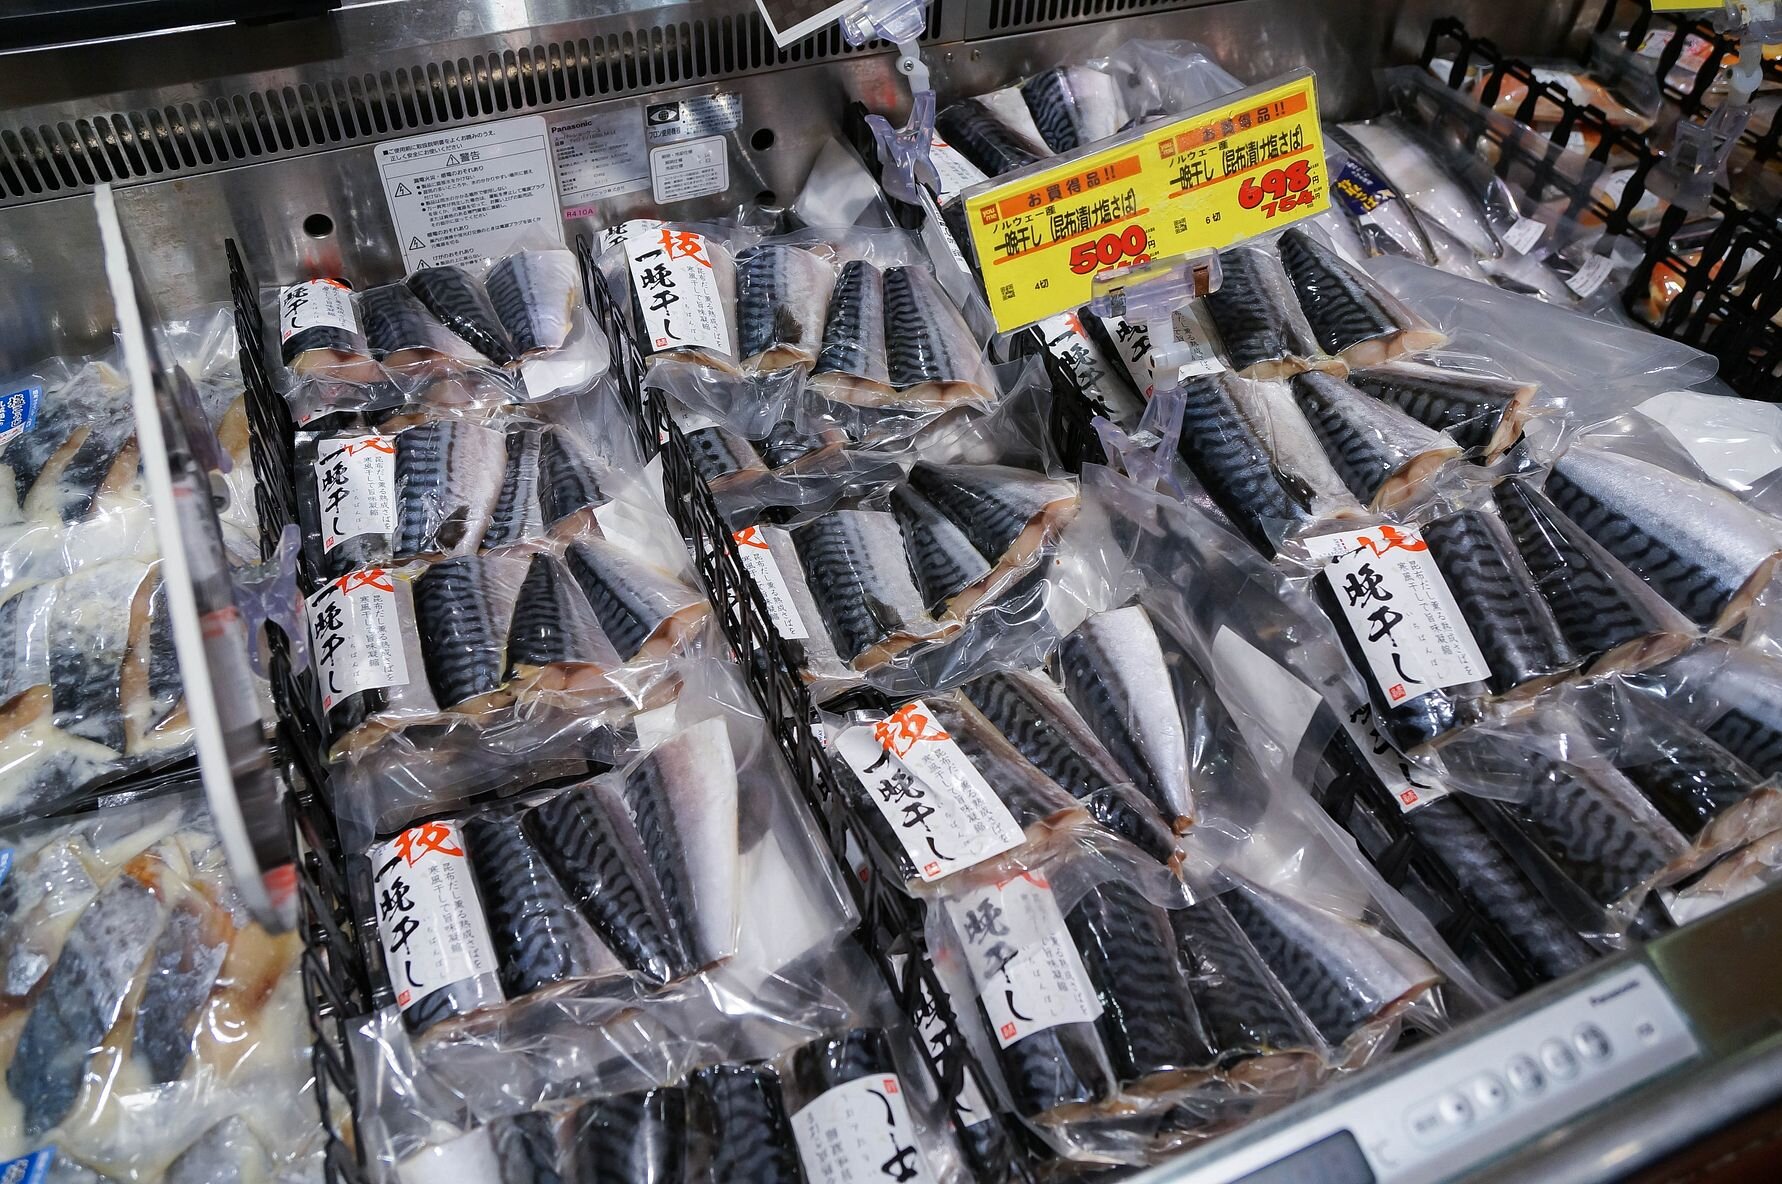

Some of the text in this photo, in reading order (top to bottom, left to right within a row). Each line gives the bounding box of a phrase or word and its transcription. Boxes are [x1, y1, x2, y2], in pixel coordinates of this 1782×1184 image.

[551, 120, 592, 133] Panasonic
[460, 151, 481, 162] 警告
[1169, 140, 1228, 168] ノルウェー産
[1170, 159, 1214, 190] 一晩干し
[1238, 160, 1311, 209] 698
[1312, 175, 1319, 185] 円
[566, 209, 594, 218] R410A
[982, 208, 995, 217] you
[993, 204, 1056, 234] ノルウェー産
[1261, 189, 1315, 218] 754
[994, 225, 1042, 256] 一晩干し
[1069, 225, 1147, 274] 500
[1148, 239, 1155, 249] 円
[635, 249, 681, 340] 一晩干し
[1035, 278, 1049, 290] 4切
[320, 448, 350, 535] 一晩干し
[1331, 546, 1424, 684] 一晩干し
[312, 585, 345, 693] 一晩干し
[863, 749, 957, 861] 一晩干し
[375, 856, 423, 987] 一晩干し
